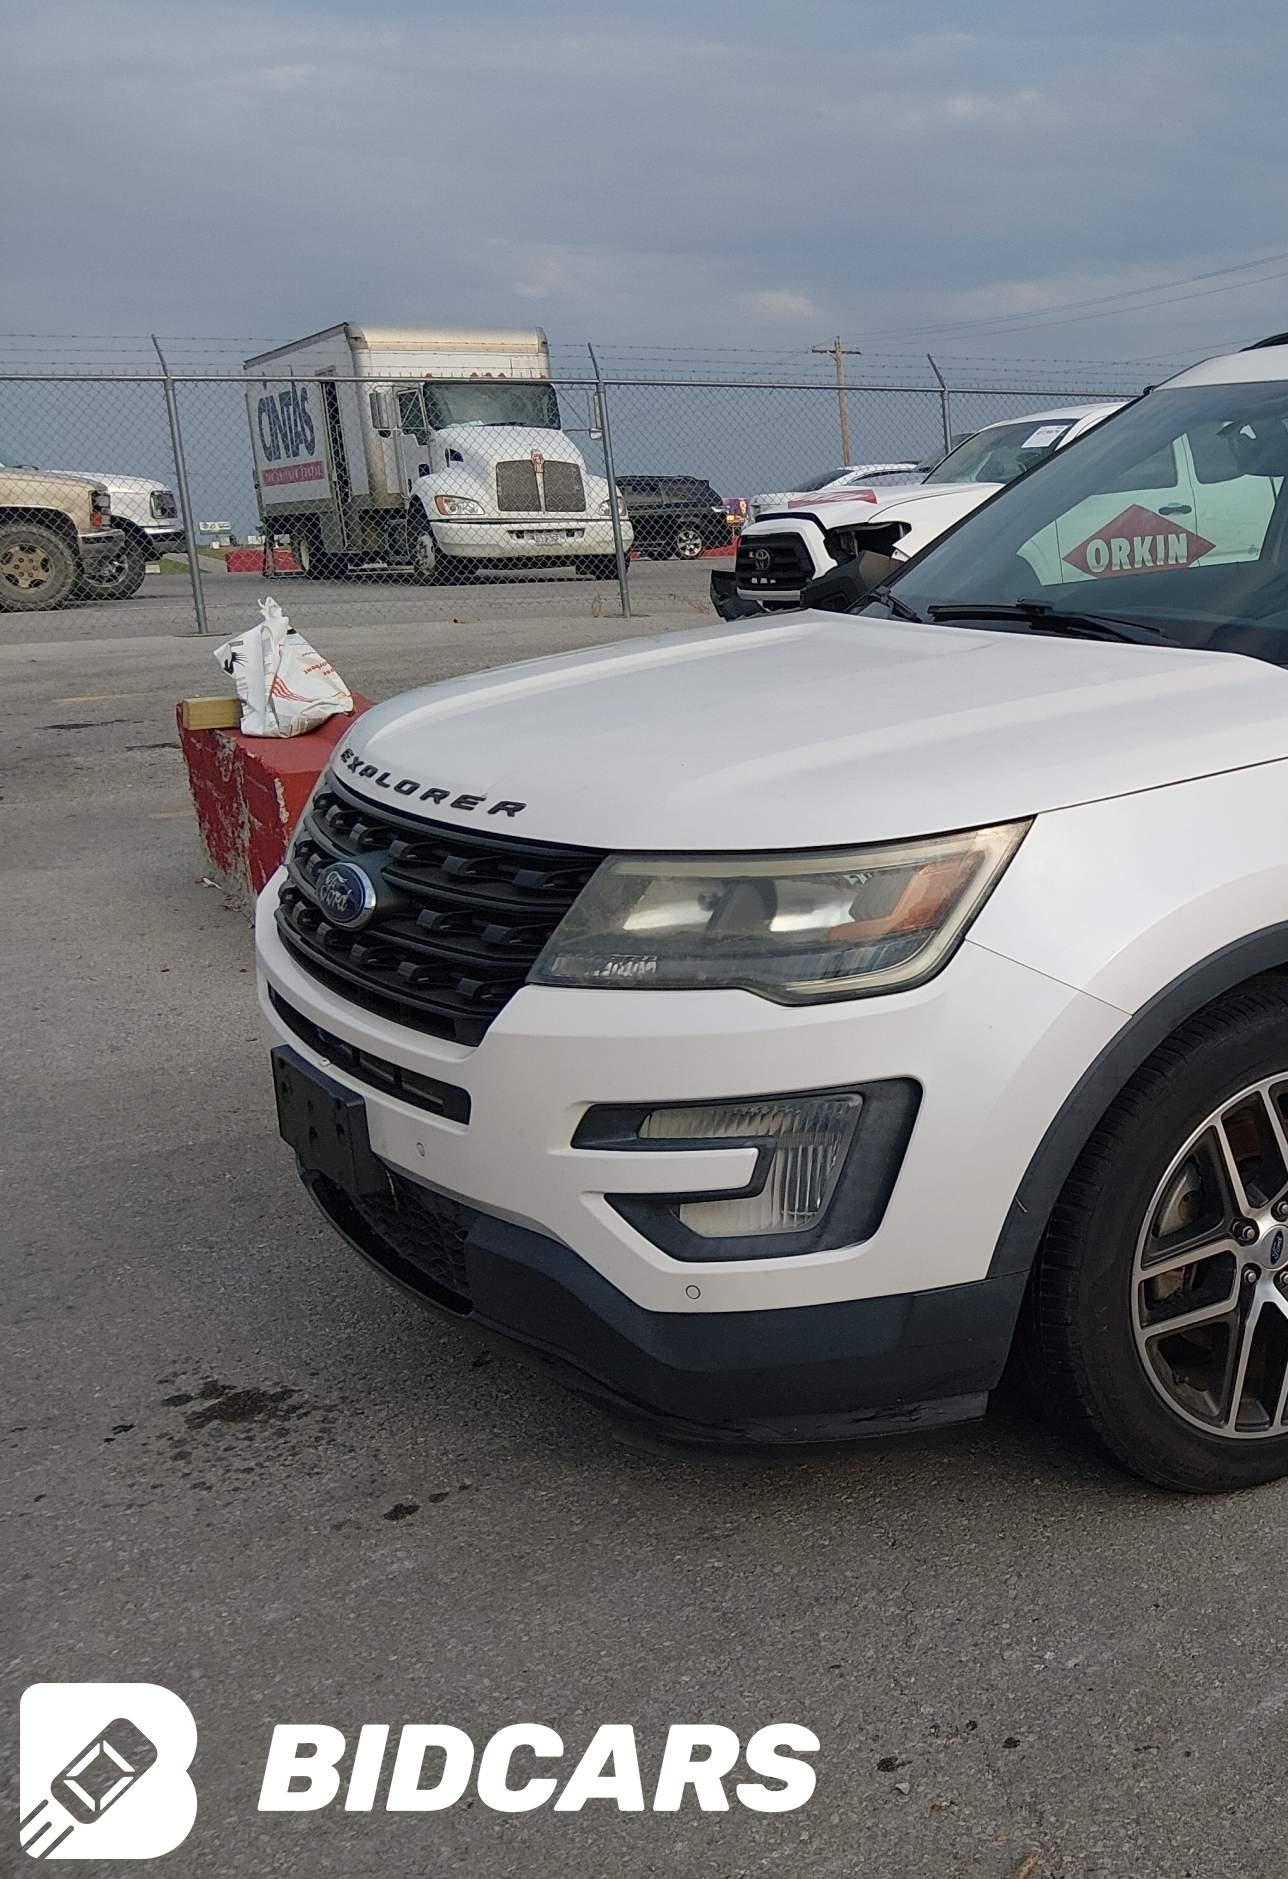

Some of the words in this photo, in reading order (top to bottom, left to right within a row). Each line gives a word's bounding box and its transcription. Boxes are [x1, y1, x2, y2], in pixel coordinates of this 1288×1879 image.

[257, 368, 316, 462] CINTAS
[1085, 532, 1188, 573] ORKIN
[339, 747, 527, 818] EXPLORER
[318, 869, 355, 914] Ford
